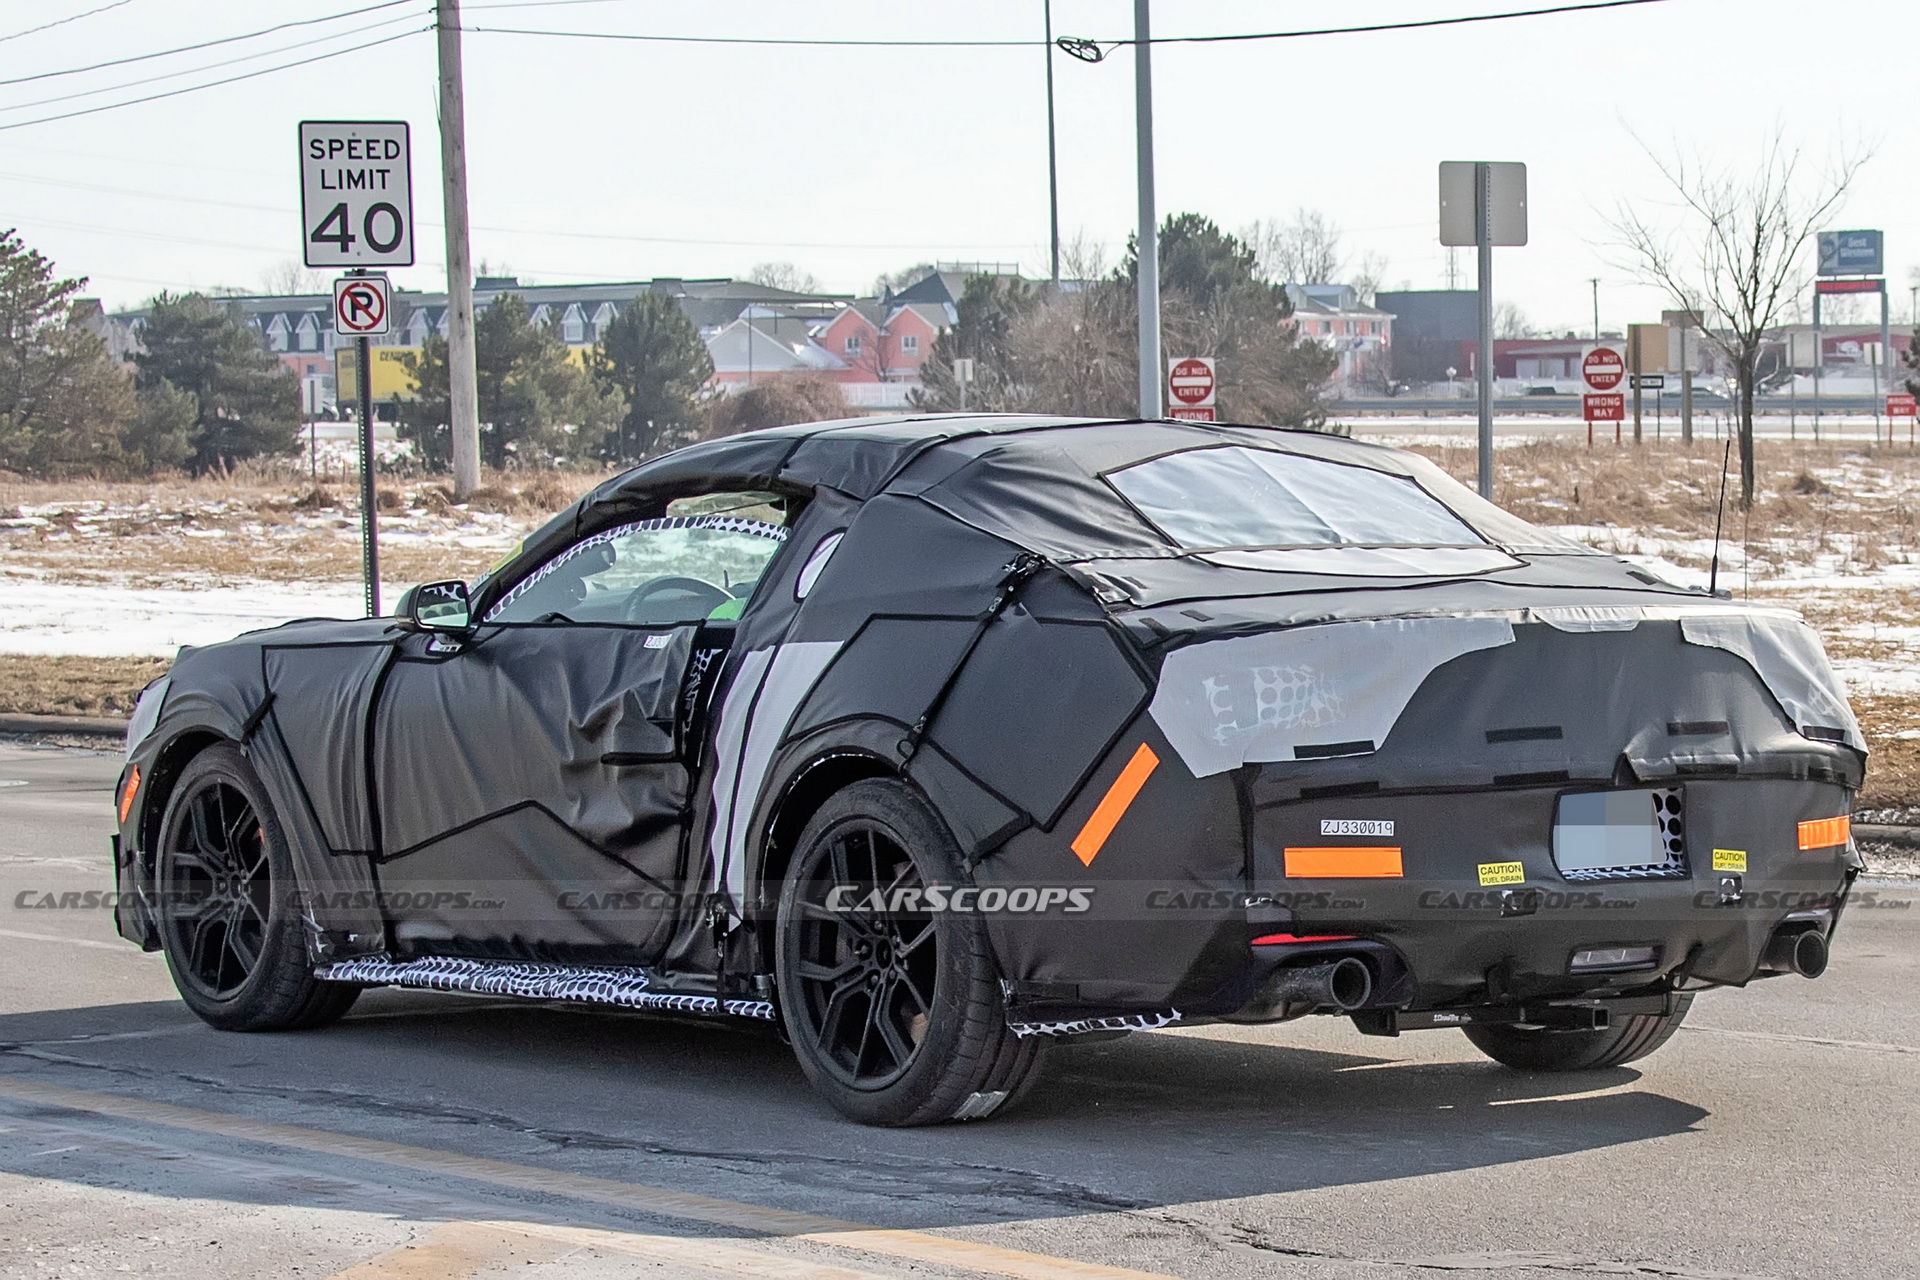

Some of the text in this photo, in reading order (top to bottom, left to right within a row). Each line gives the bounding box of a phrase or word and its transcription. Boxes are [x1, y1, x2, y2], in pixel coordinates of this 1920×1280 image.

[310, 139, 400, 160] SPEED
[321, 169, 390, 189] LIMIT
[310, 202, 403, 254] 40
[350, 291, 373, 322] P
[1588, 355, 1618, 364] DO NOT
[1175, 367, 1207, 376] DO NOT
[1591, 375, 1616, 384] ENTER
[1178, 387, 1205, 397] ENTER
[1587, 397, 1621, 407] WRONG
[1593, 408, 1615, 418] WAY
[1322, 821, 1393, 834] ZJ330019
[1714, 852, 1745, 862] CAUTION
[1480, 864, 1522, 875] CAUTION
[1482, 874, 1523, 884] FUEL DRAIN
